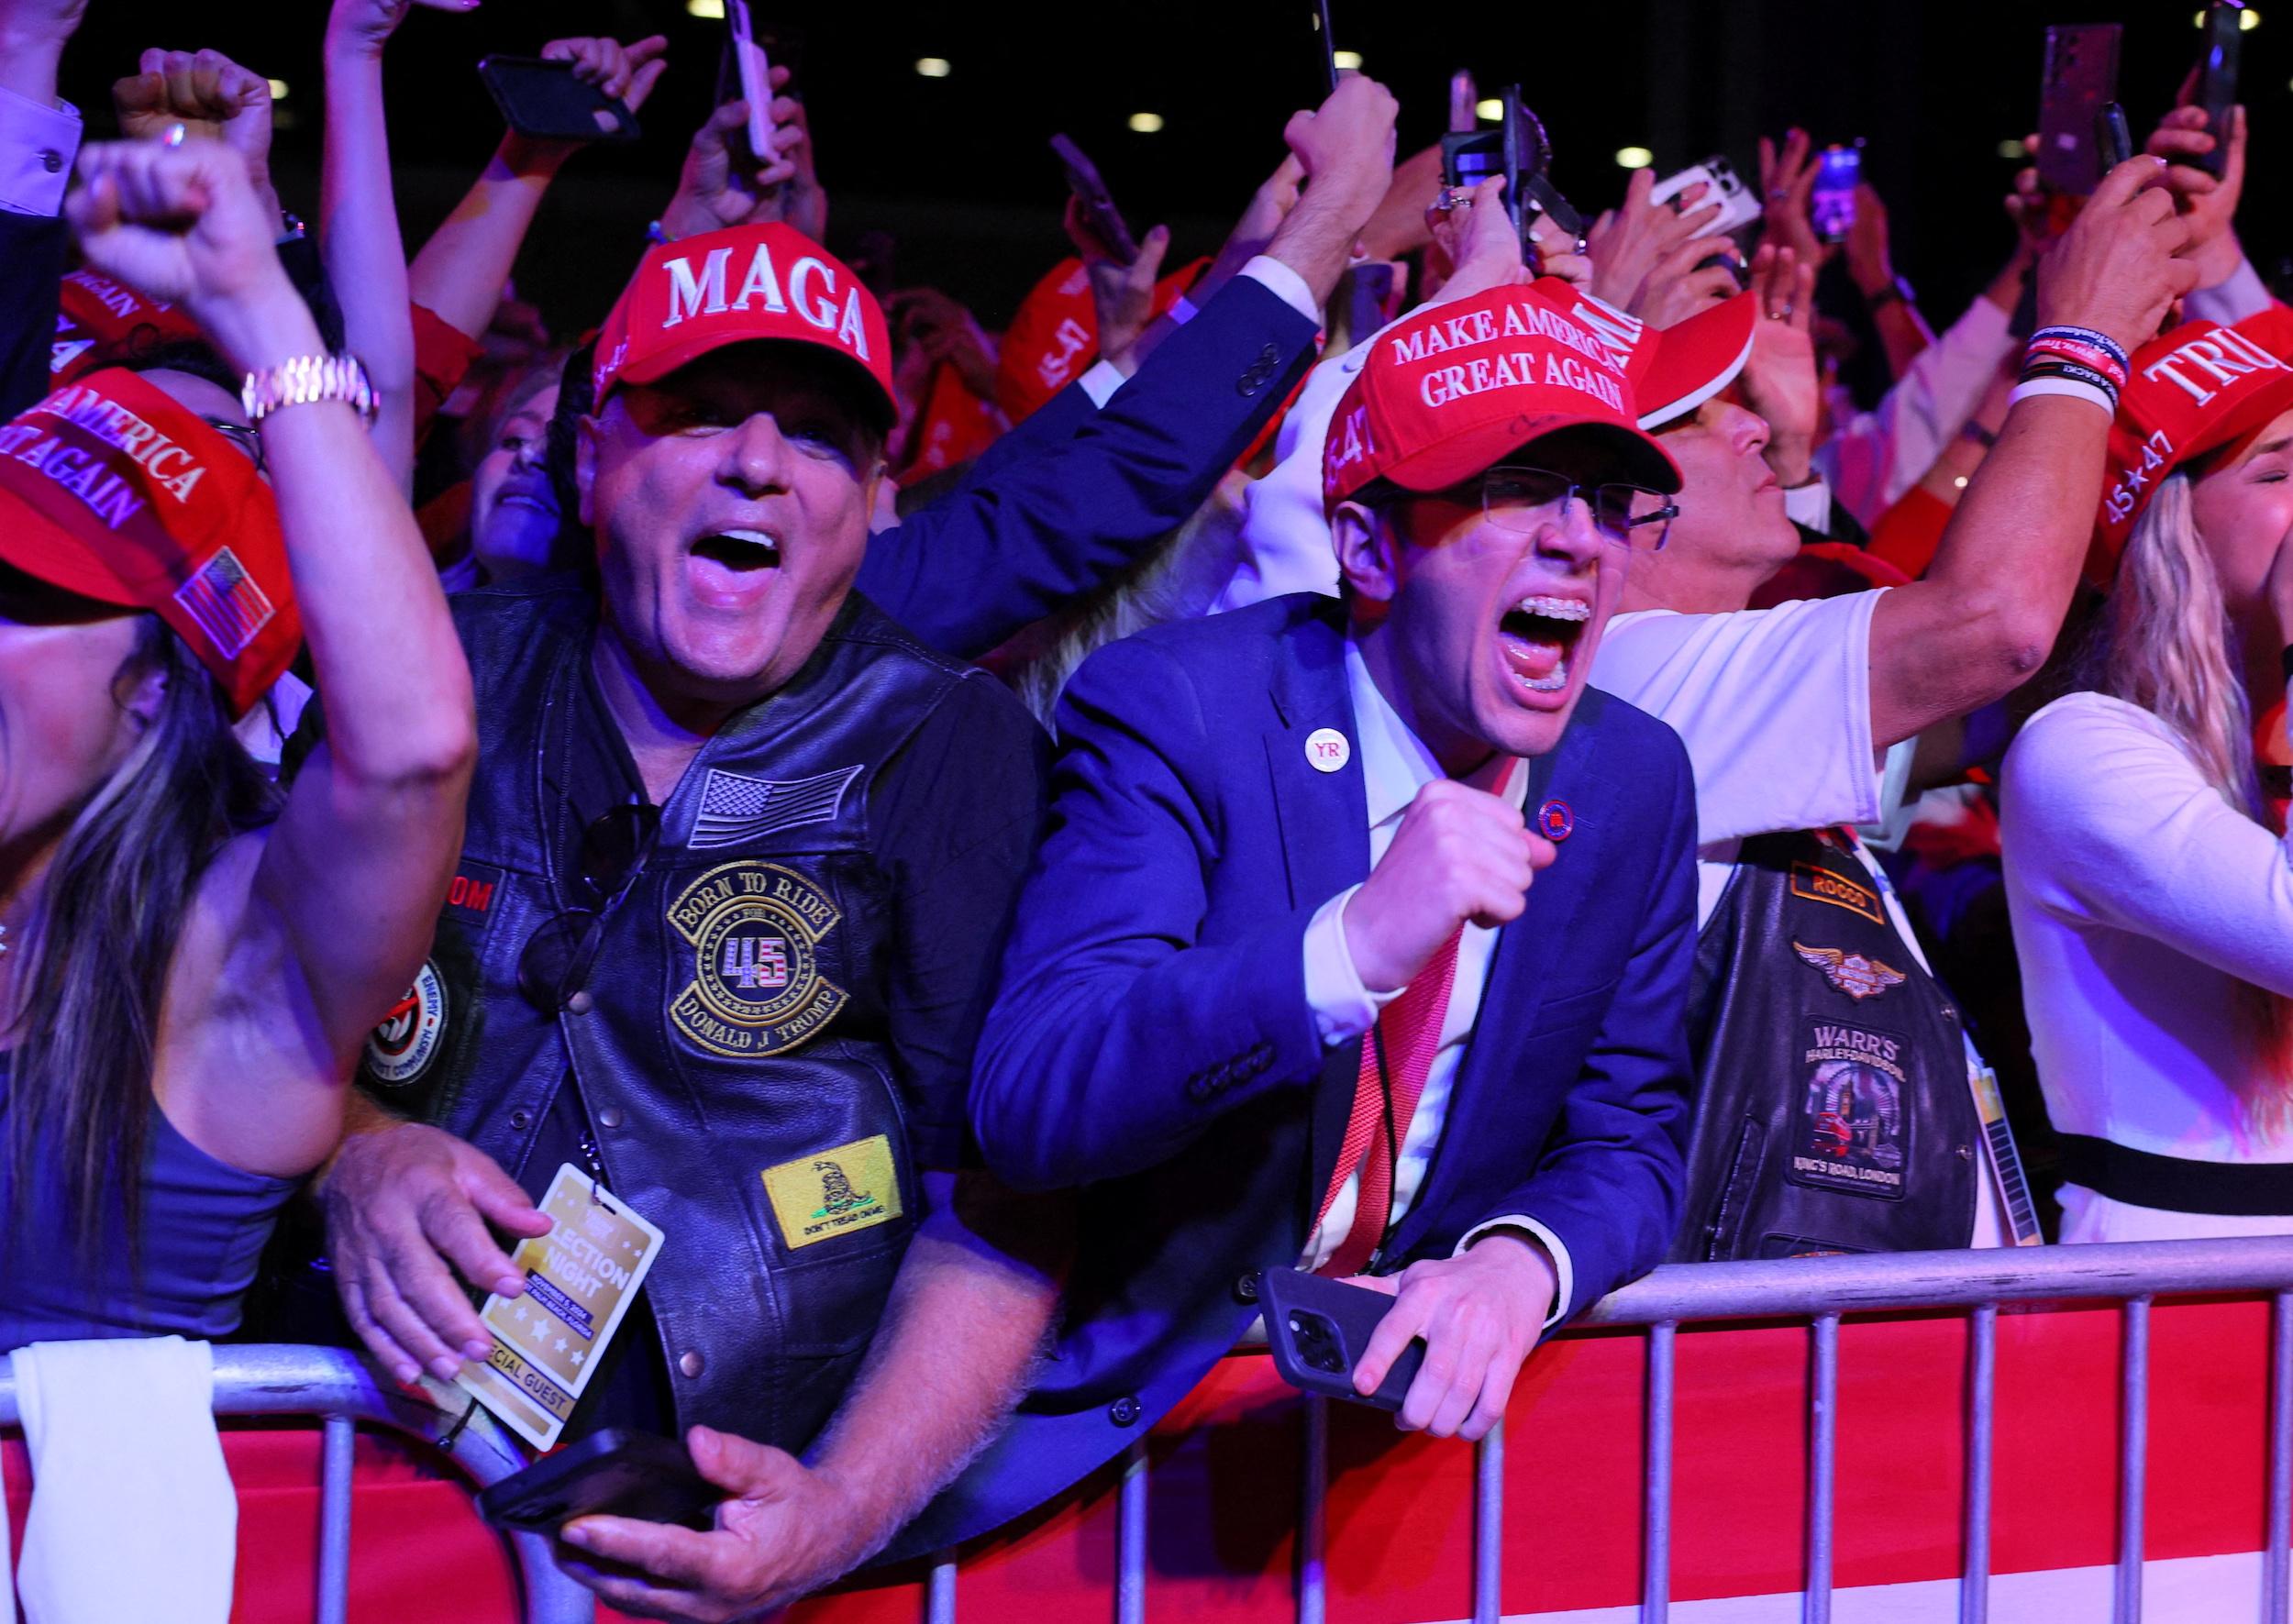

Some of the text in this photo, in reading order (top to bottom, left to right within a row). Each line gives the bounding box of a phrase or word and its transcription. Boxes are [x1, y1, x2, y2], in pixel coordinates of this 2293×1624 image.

[662, 242, 871, 361] MAGA
[1391, 303, 1627, 380] MAKE AMERICA
[2143, 327, 2293, 406] TRU
[1421, 351, 1625, 414] GREAT AGAIN
[40, 386, 206, 503] AMERICA
[15, 436, 145, 530] AGAIN
[1314, 742, 1340, 757] YR
[448, 876, 493, 911] OM
[677, 872, 833, 928] BORN TO RIDE
[721, 937, 789, 989] 45
[421, 974, 439, 1018] ENEMY
[678, 990, 836, 1049] DONALD J TRUMP
[1813, 1025, 1901, 1062] WARR'S
[1858, 1166, 1901, 1186] LONDON
[543, 1245, 604, 1298] NIGHT
[488, 1344, 568, 1411] ECIAL GUEST
